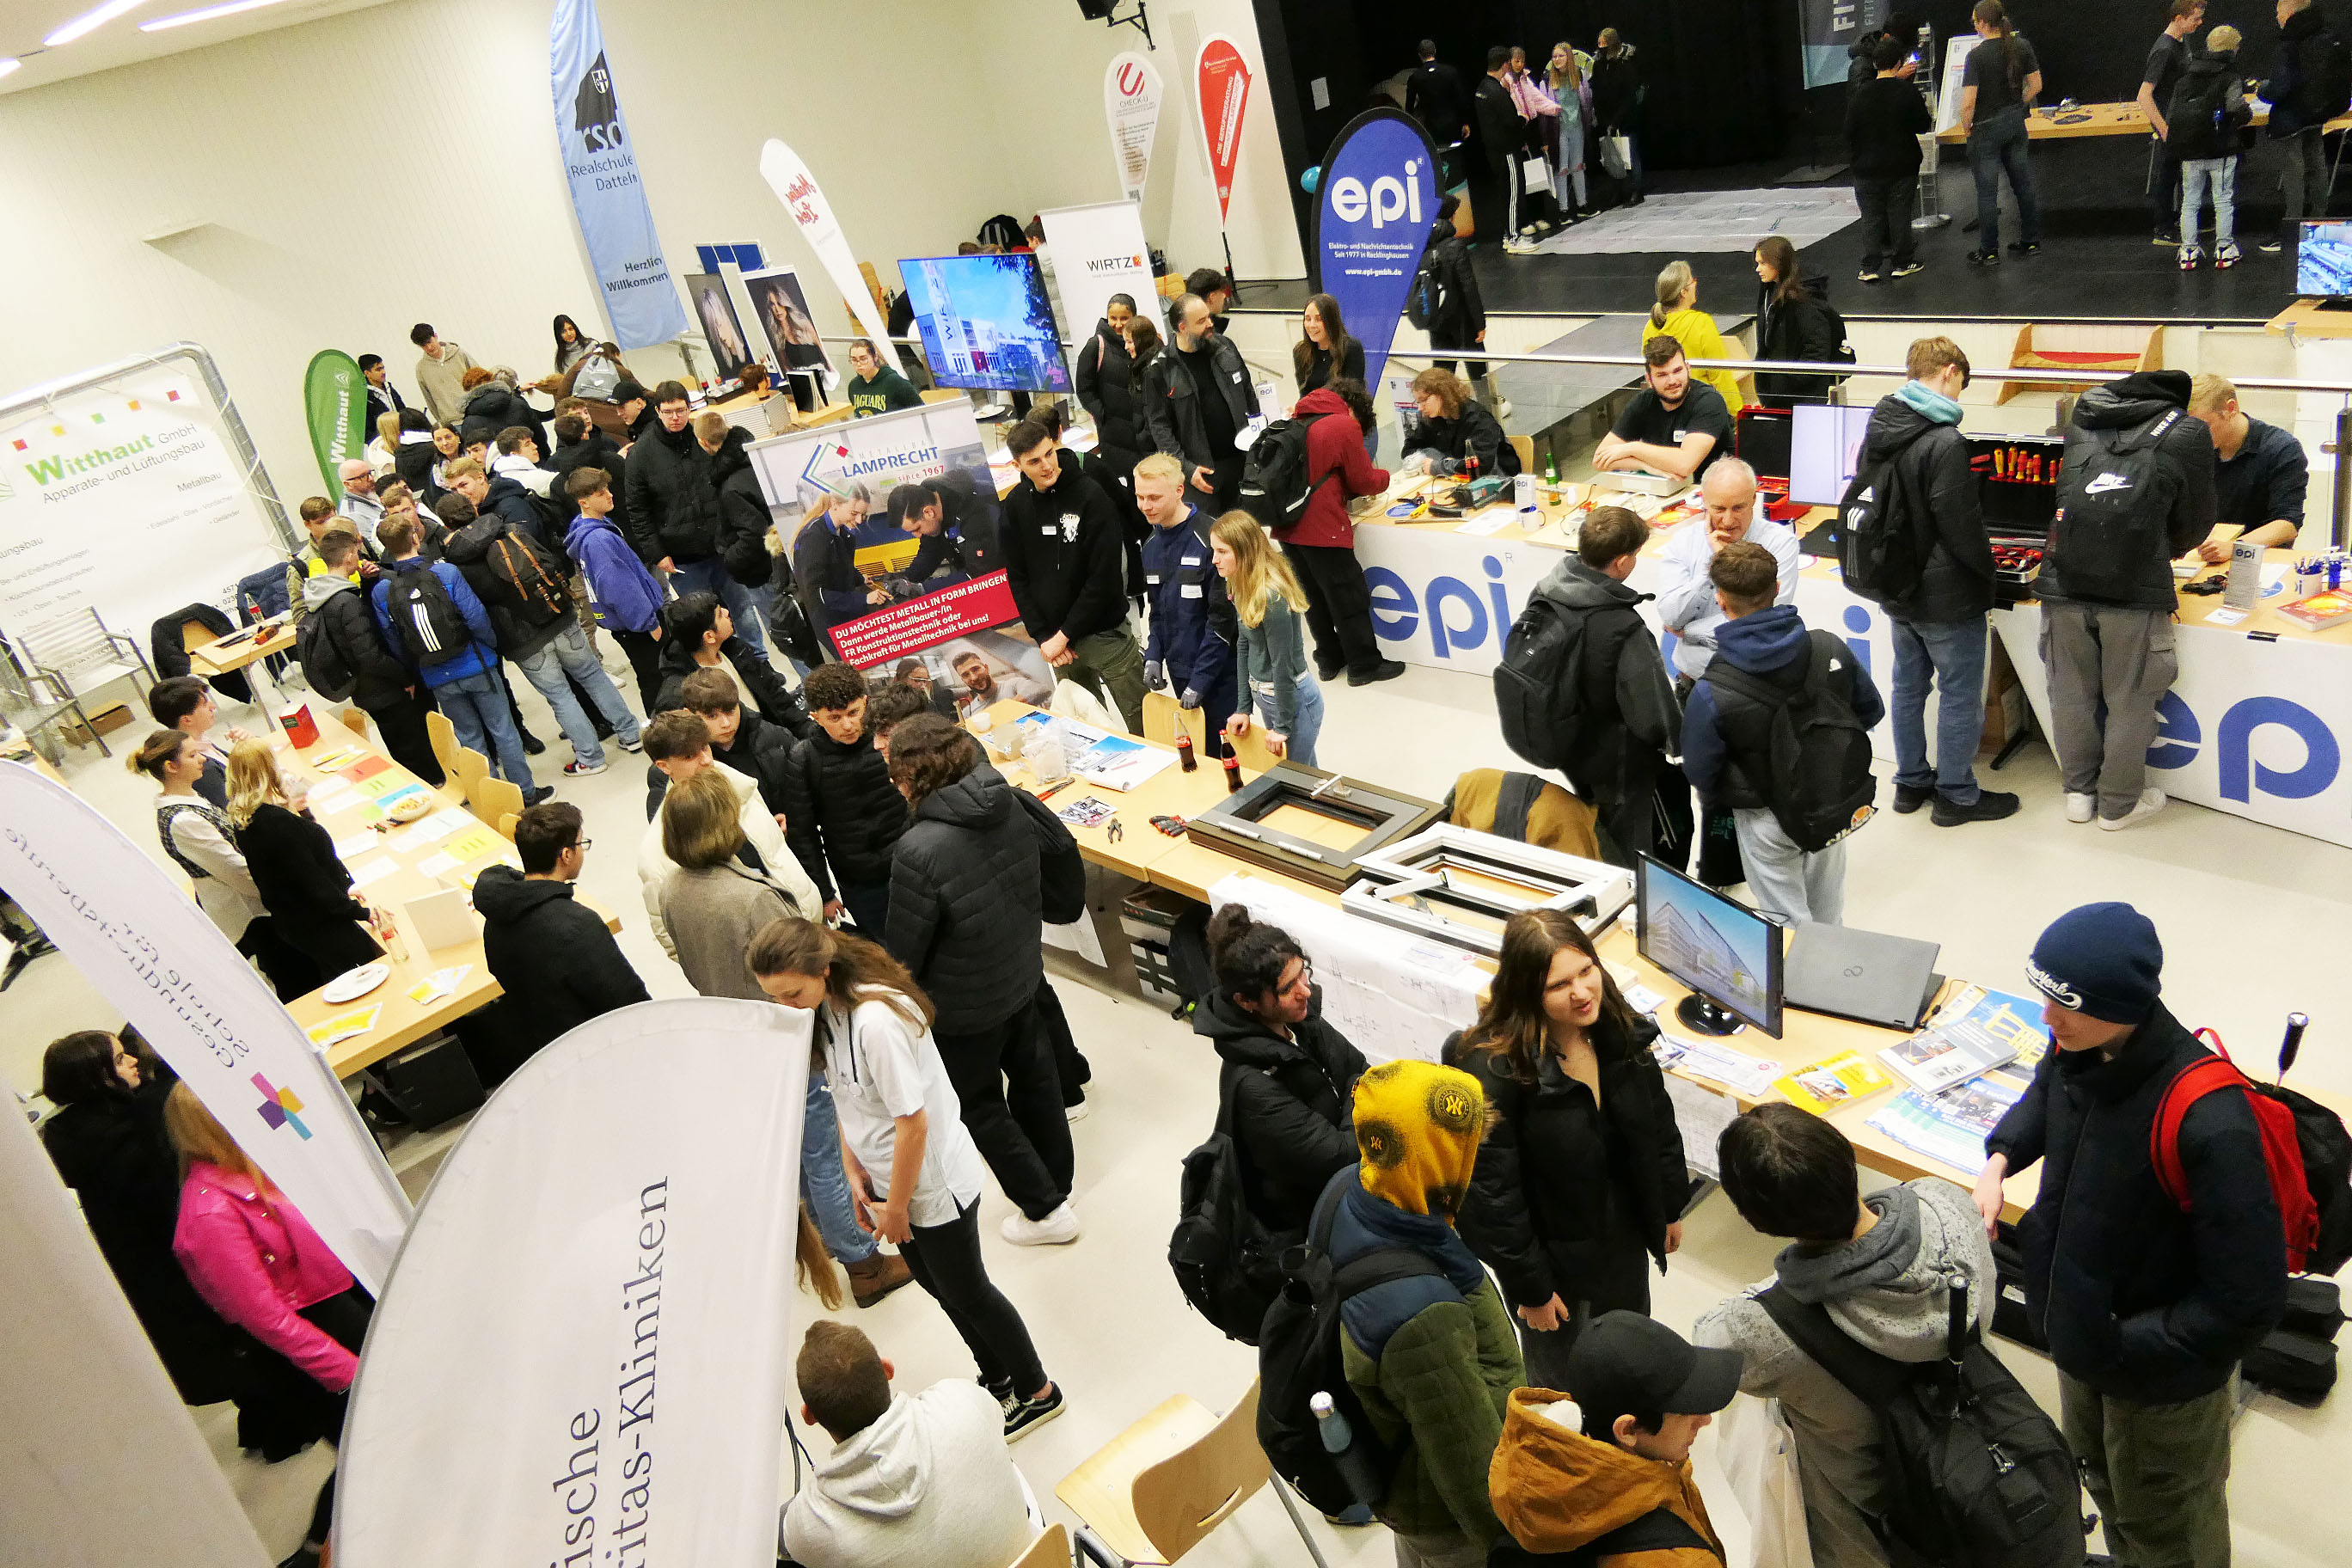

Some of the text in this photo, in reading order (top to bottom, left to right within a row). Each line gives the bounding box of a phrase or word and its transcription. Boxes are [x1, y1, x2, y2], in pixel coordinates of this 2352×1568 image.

[1833, 0, 1855, 32] FI
[571, 154, 634, 178] Realschule
[596, 172, 638, 191] Datteln
[1332, 160, 1421, 229] epi
[1328, 242, 1349, 250] Elektro-
[1361, 242, 1413, 250] Nachrichtentechnik
[1366, 251, 1410, 260] Recklinghausen
[1086, 256, 1133, 272] WIRTZ
[1344, 267, 1403, 277] www.epi-gmbh.de
[330, 389, 349, 463] Witthaut
[2149, 420, 2170, 437] NIKE
[24, 422, 198, 486] Witthaut GmbH
[842, 446, 938, 478] LAMPRECHT
[860, 439, 926, 460] METALLBA
[43, 438, 206, 505] Apparate- und Lüftungsbau
[177, 471, 223, 493] Metallbau
[898, 465, 945, 482] since 1967
[2090, 494, 2119, 506] AIR
[2236, 548, 2256, 560] epi
[835, 574, 1008, 640] DU MÖCHTEST METALL IN FORM BRINGEN
[1363, 555, 1514, 658] epi
[840, 603, 952, 649] Dann werde Metallbauer-/in
[844, 611, 962, 658] FR Konstruktionstechnik oder
[848, 613, 989, 666] Fachkraft für Metalltechnik bei uns!
[2145, 689, 2340, 805] ep
[549, 1407, 601, 1568] ische
